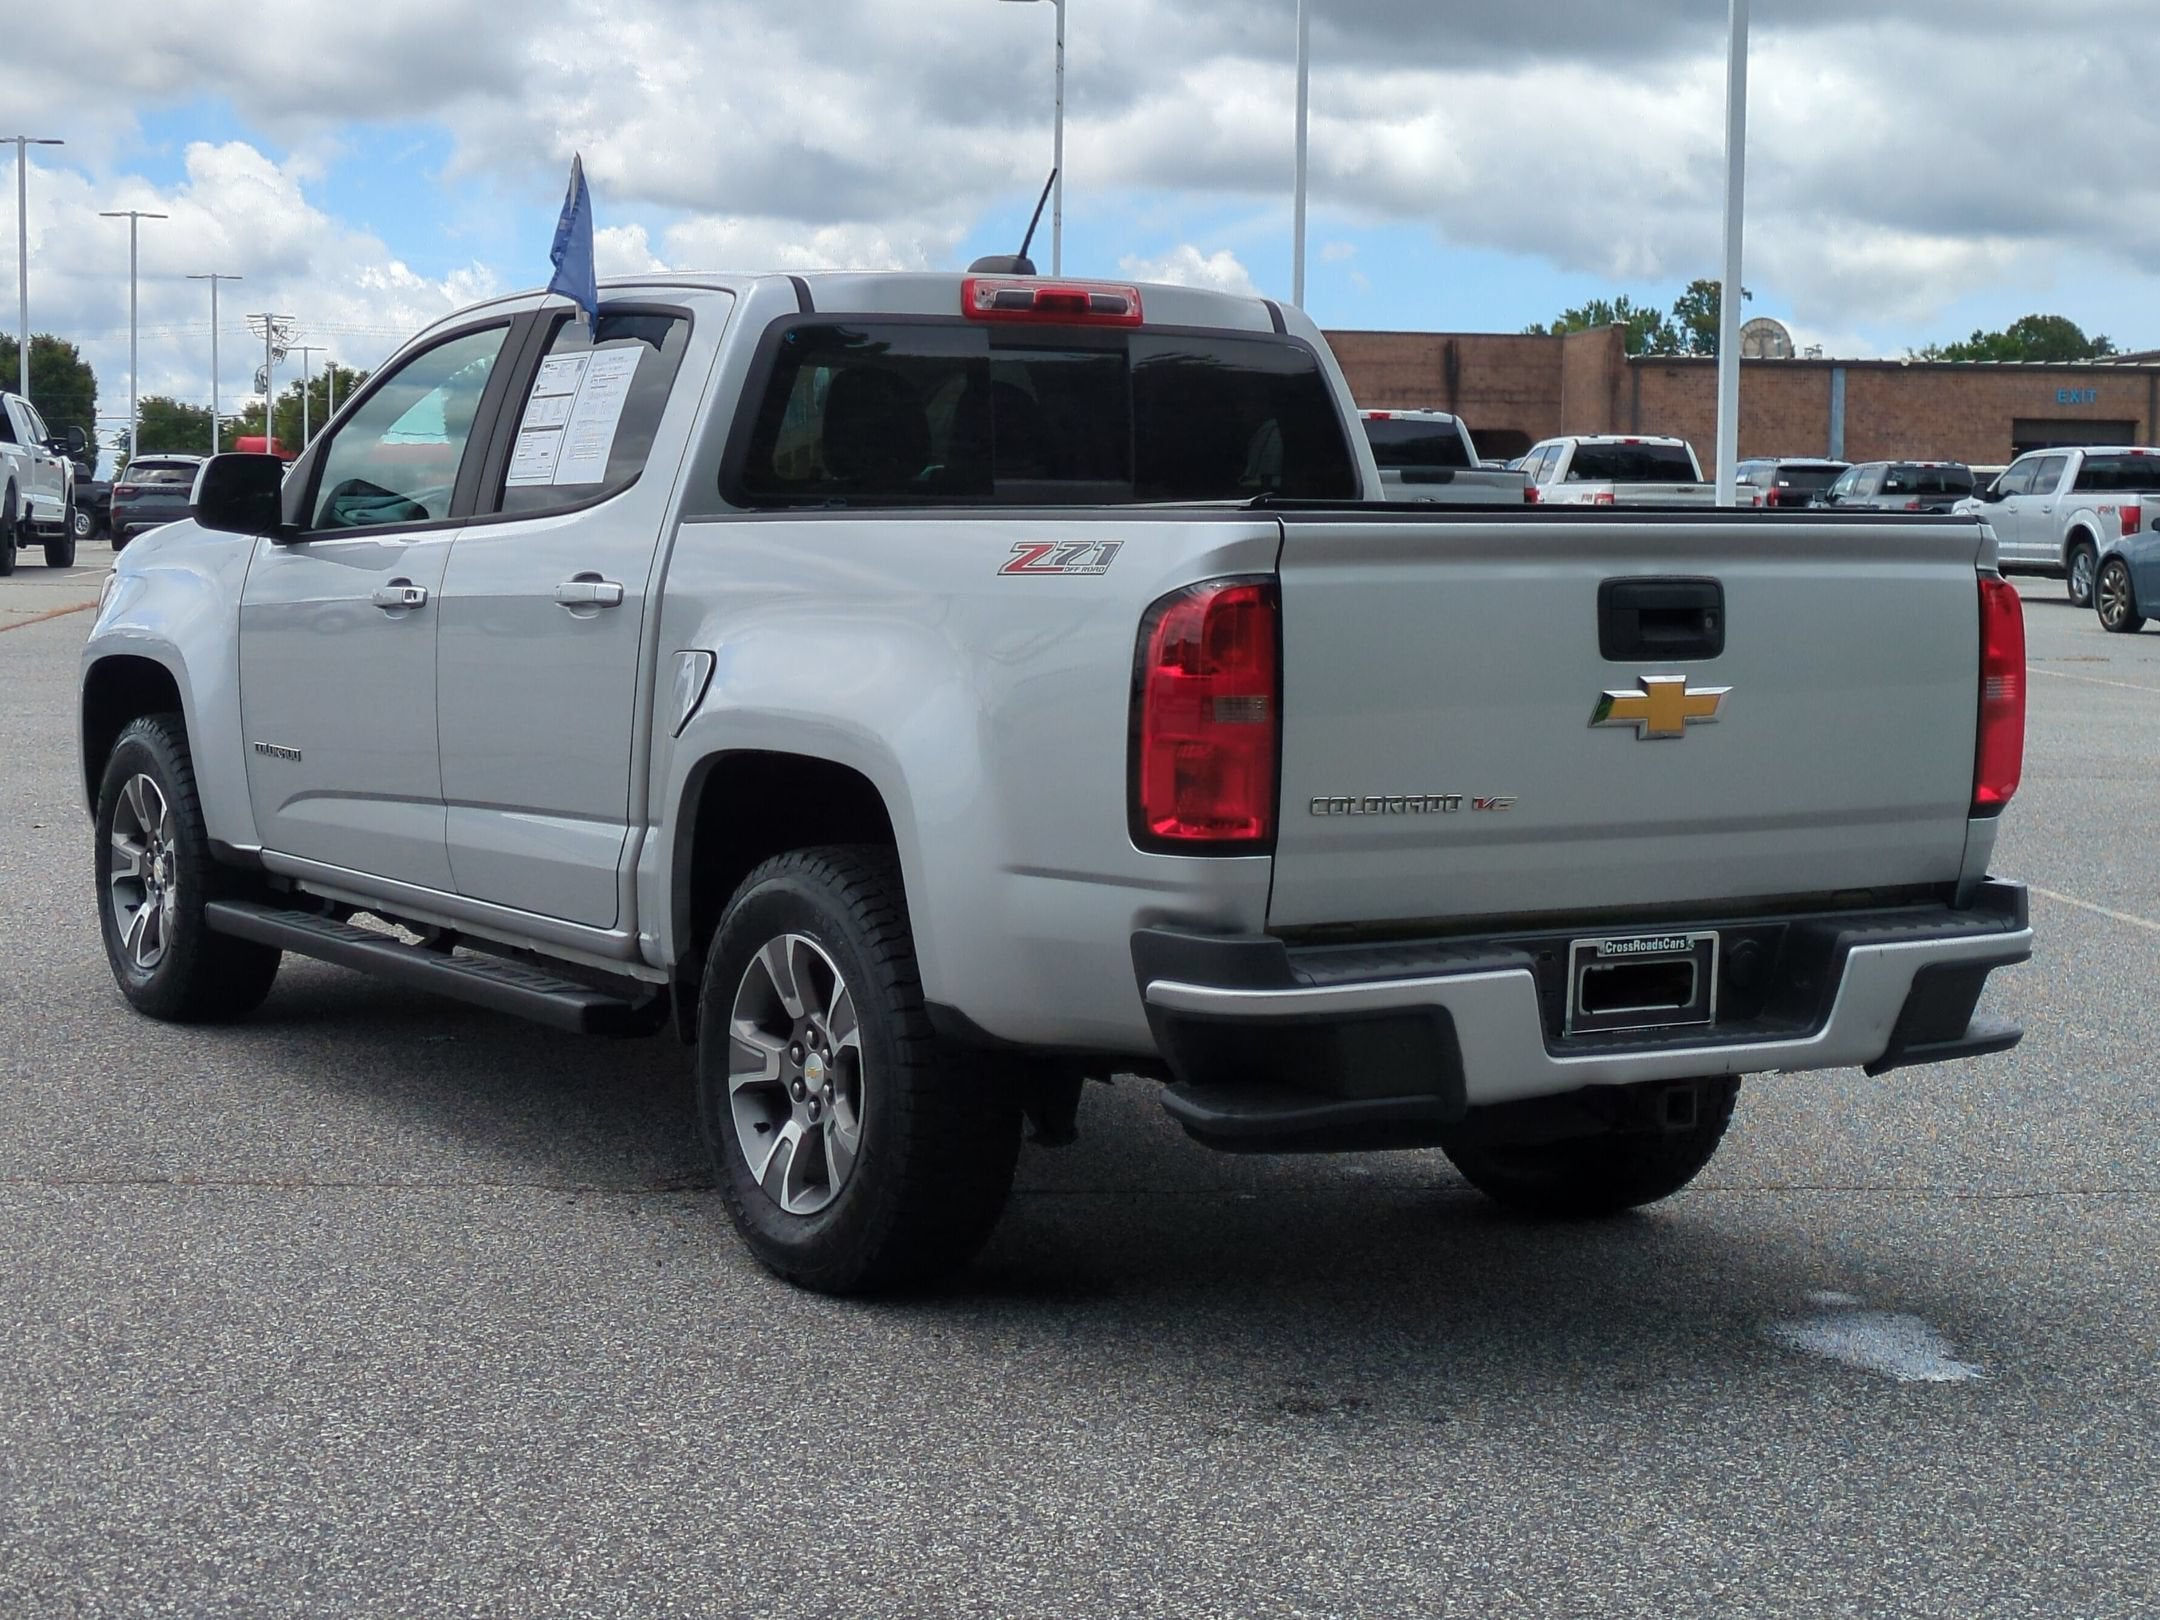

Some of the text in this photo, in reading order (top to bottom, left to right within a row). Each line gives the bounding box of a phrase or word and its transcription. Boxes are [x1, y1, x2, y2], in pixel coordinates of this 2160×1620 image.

[2057, 388, 2096, 403] EXIT
[998, 540, 1123, 575] Z71
[1311, 794, 1463, 816] COLORADO
[1605, 938, 1685, 953] CrossRoadsCars
